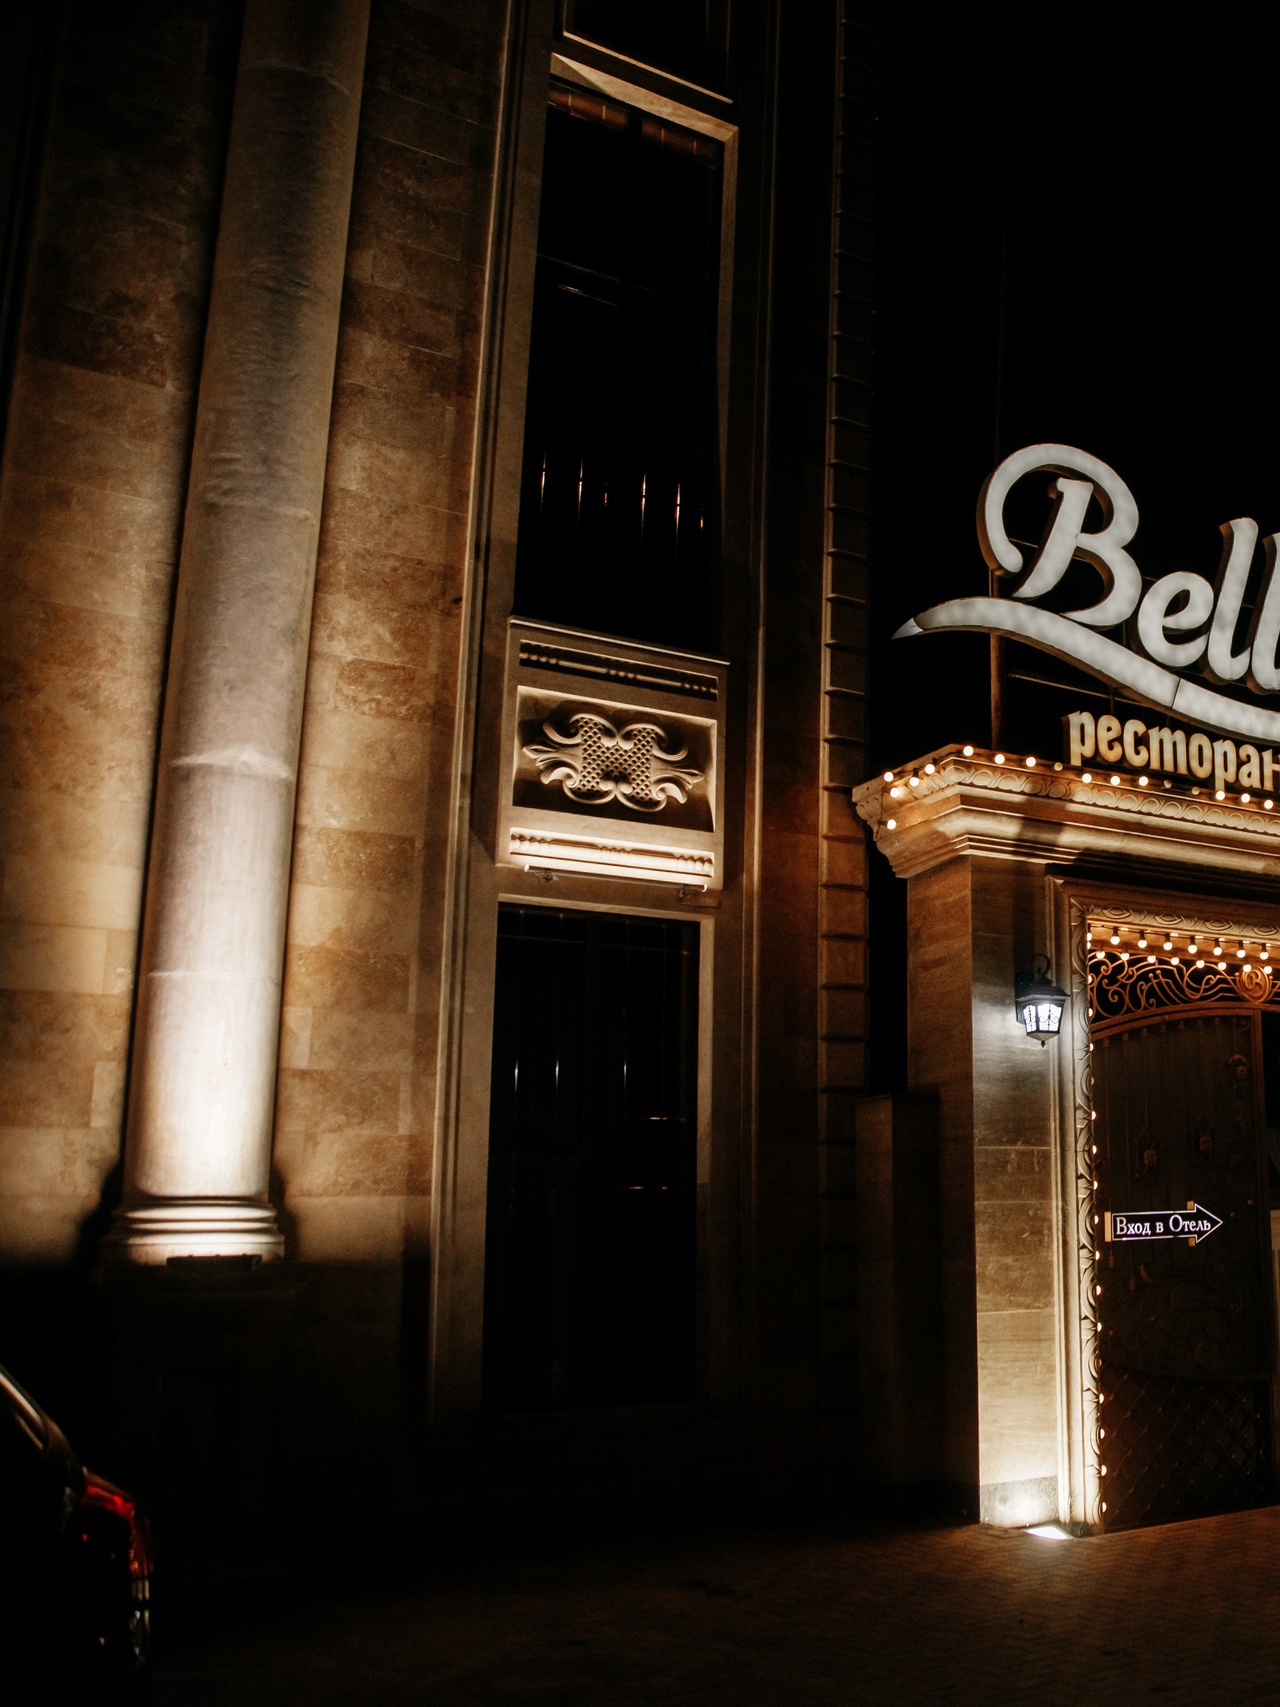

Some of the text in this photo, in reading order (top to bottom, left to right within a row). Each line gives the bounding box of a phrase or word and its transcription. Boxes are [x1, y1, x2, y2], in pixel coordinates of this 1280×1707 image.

[1116, 1214, 1211, 1236] Вход в Отель
